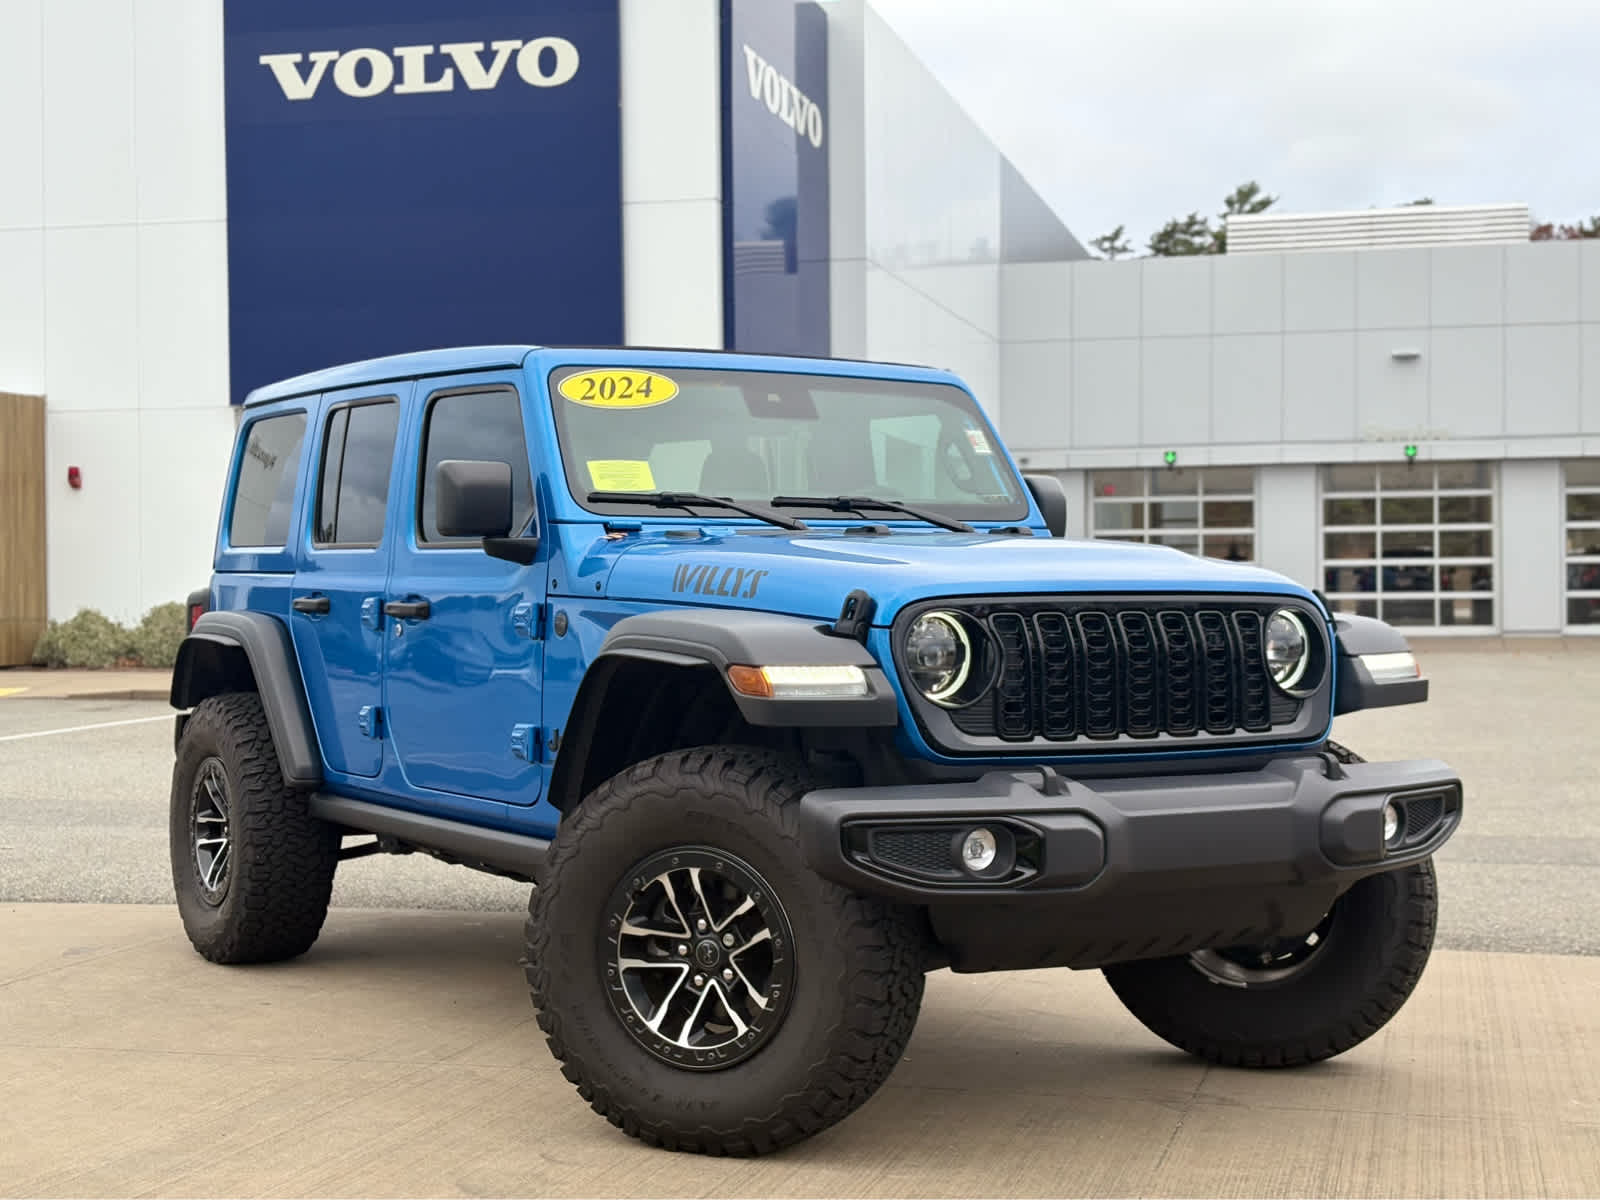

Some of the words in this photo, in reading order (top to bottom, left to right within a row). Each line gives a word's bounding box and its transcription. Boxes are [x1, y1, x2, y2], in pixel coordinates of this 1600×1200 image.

[259, 36, 580, 100] VOLVO
[743, 43, 822, 148] VOLVO
[580, 376, 653, 401] 2024
